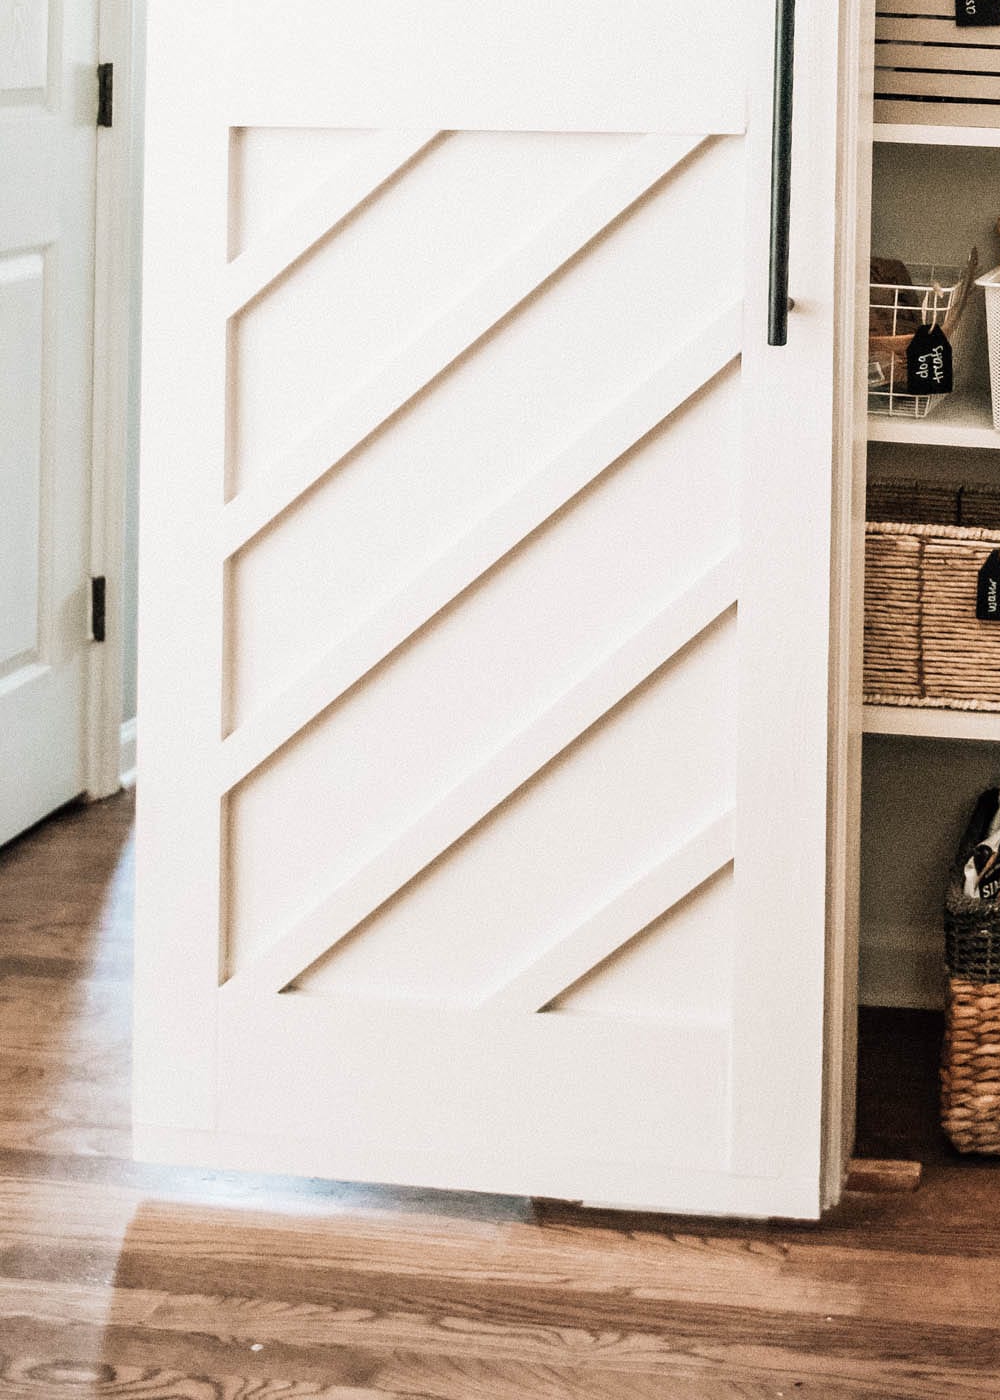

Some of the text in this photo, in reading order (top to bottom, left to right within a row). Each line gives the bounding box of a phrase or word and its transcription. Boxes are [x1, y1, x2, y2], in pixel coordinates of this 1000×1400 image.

[916, 354, 932, 378] dog
[930, 344, 944, 383] treats
[988, 579, 997, 612] water
